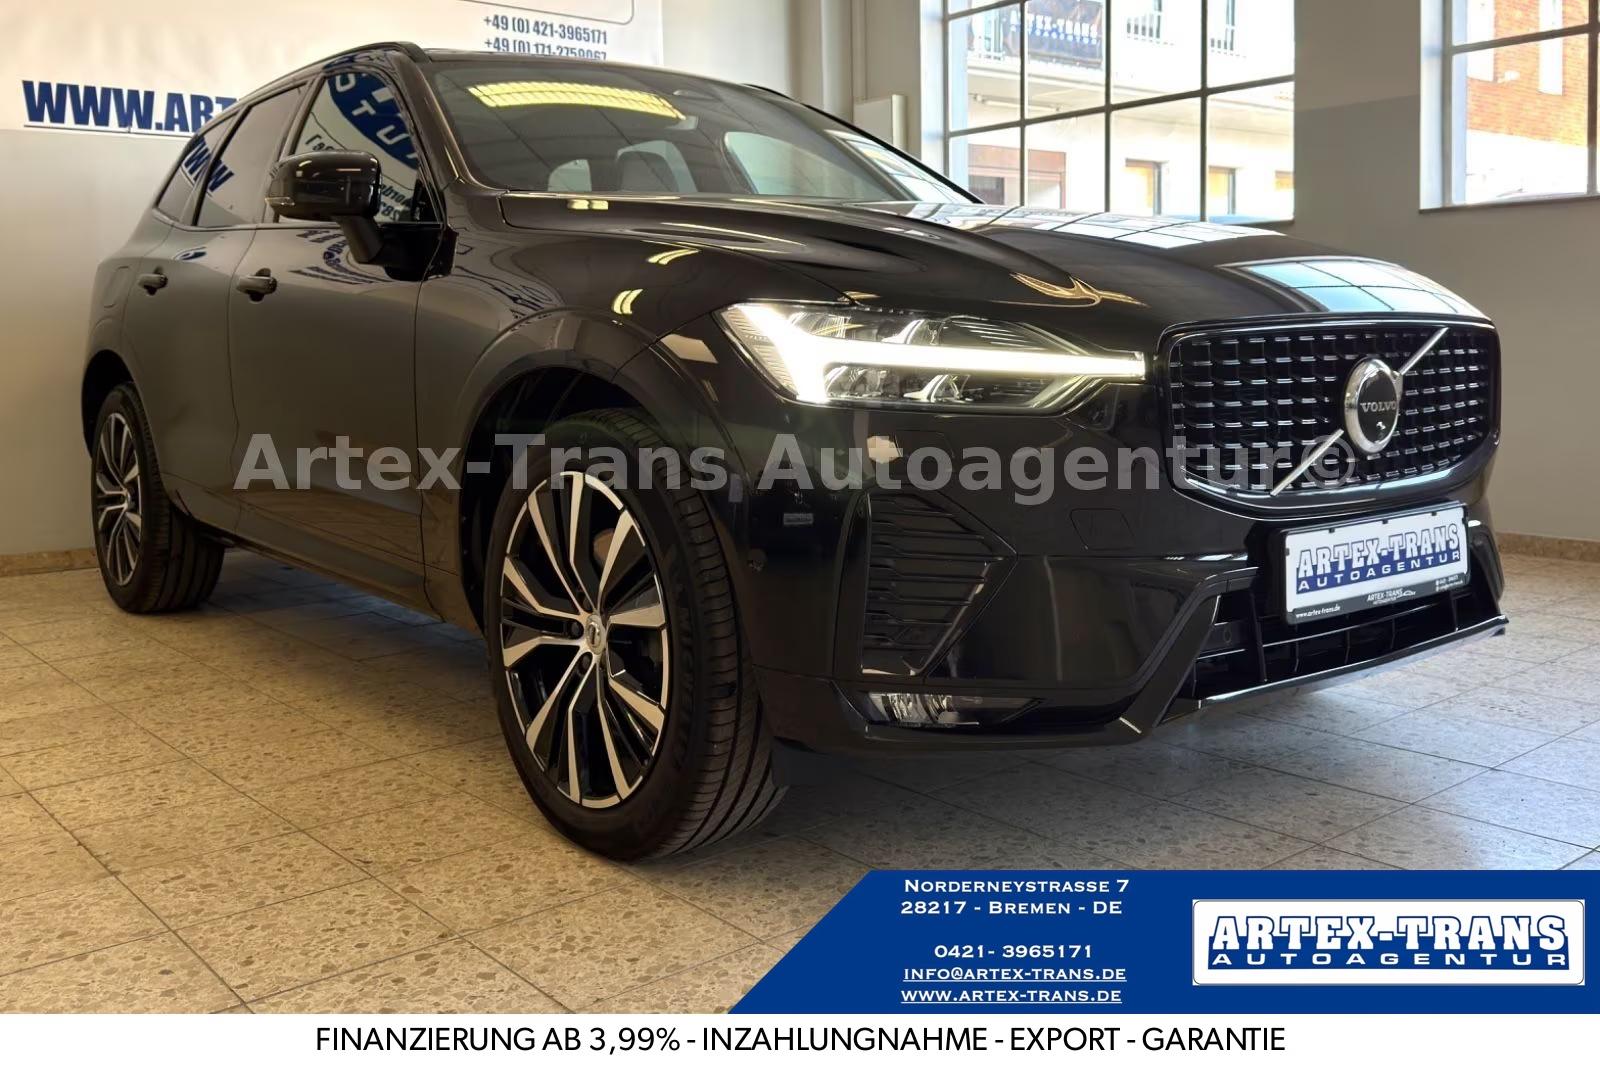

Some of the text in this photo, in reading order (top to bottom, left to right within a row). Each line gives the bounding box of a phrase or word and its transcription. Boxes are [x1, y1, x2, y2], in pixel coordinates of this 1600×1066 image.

[484, 14, 508, 31] +49
[532, 20, 607, 45] 421-3965171
[1360, 401, 1397, 412] VOLVO
[1298, 523, 1460, 579] ARTEX-TRANS
[1298, 552, 1461, 591] AUTOAGENTUR
